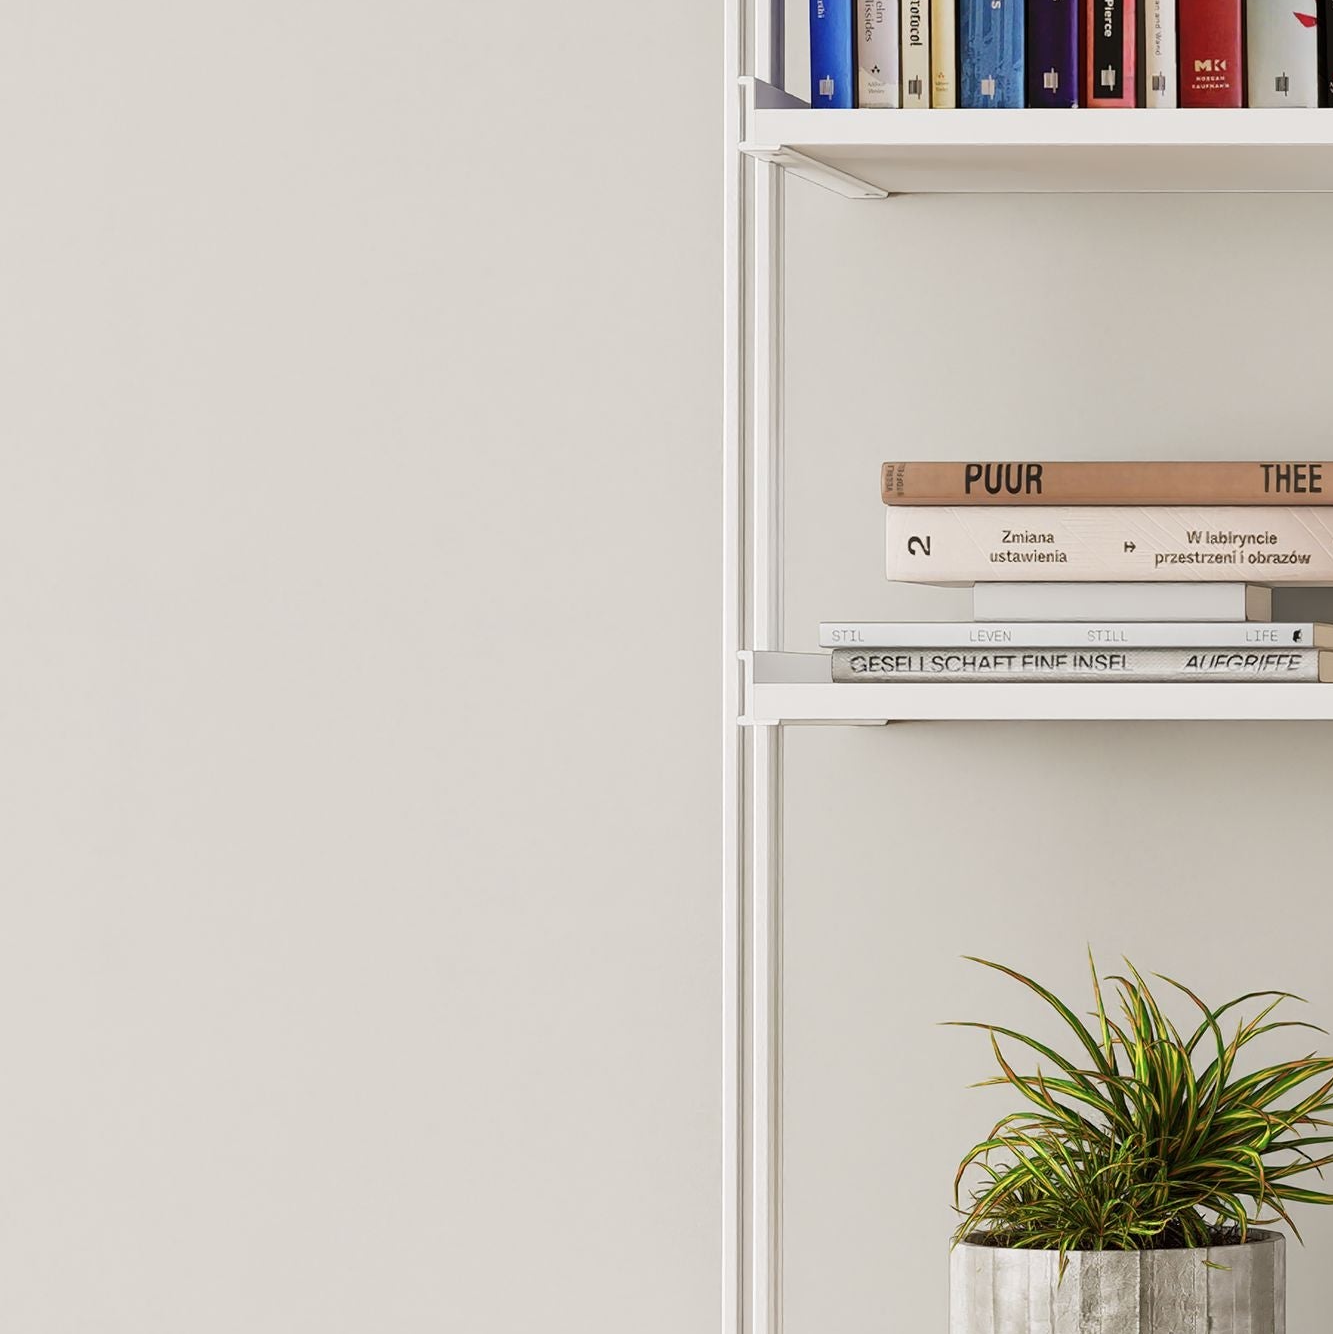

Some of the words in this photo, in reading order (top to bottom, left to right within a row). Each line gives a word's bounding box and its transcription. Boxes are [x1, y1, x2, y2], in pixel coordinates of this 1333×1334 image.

[964, 464, 1042, 494] PUUR
[1260, 464, 1322, 493] THEE
[1001, 530, 1054, 546] Zmiana
[989, 550, 1068, 564] ustawienia
[832, 630, 864, 642] STIL
[968, 630, 1012, 642] LEVEN
[1086, 630, 1128, 642] STILL
[1245, 630, 1278, 642] LIFE
